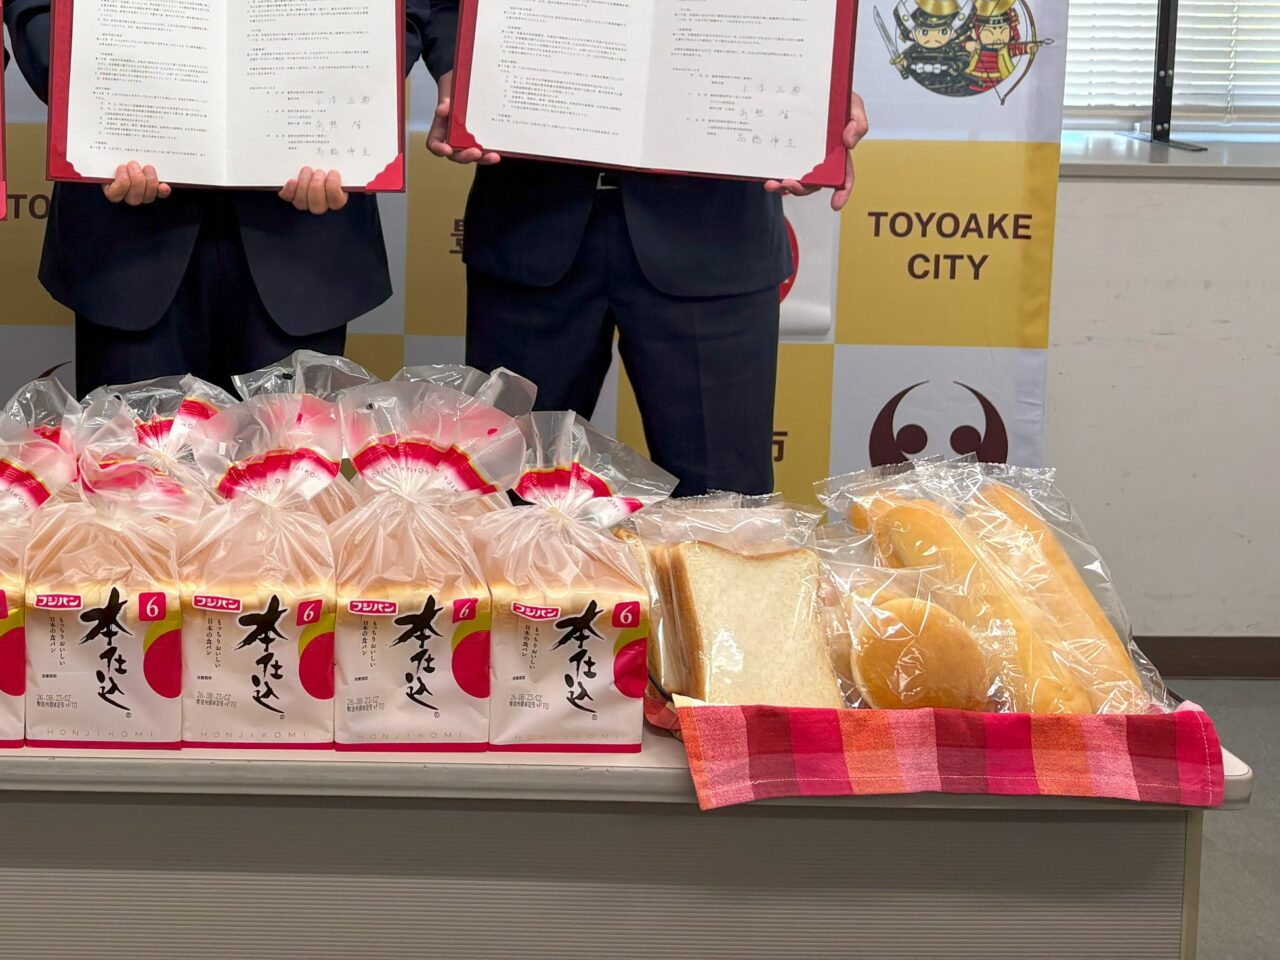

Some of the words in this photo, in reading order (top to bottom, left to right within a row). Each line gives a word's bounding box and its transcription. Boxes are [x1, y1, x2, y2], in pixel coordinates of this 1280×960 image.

[867, 211, 1034, 241] TOYOAKE
[906, 253, 989, 281] CITY
[36, 595, 82, 608] フジパン
[146, 596, 159, 618] 6
[195, 596, 240, 610] フジパン
[302, 601, 315, 622] 6
[349, 601, 397, 614] フジパン
[458, 599, 470, 620] 6
[514, 603, 558, 619] フジパン
[619, 603, 633, 625] 6
[49, 615, 57, 655] 日本の食パン
[205, 616, 213, 657] 日本の食パン
[361, 619, 370, 657] 日本の食パン
[520, 623, 532, 659] 日本の食パン
[77, 587, 133, 711] 本仕込
[233, 594, 289, 714] 本仕込
[385, 594, 444, 712] 本仕込
[548, 598, 605, 713] 本仕込
[46, 727, 154, 738] HONJIKOMI
[199, 729, 308, 739] HONJIKOMI
